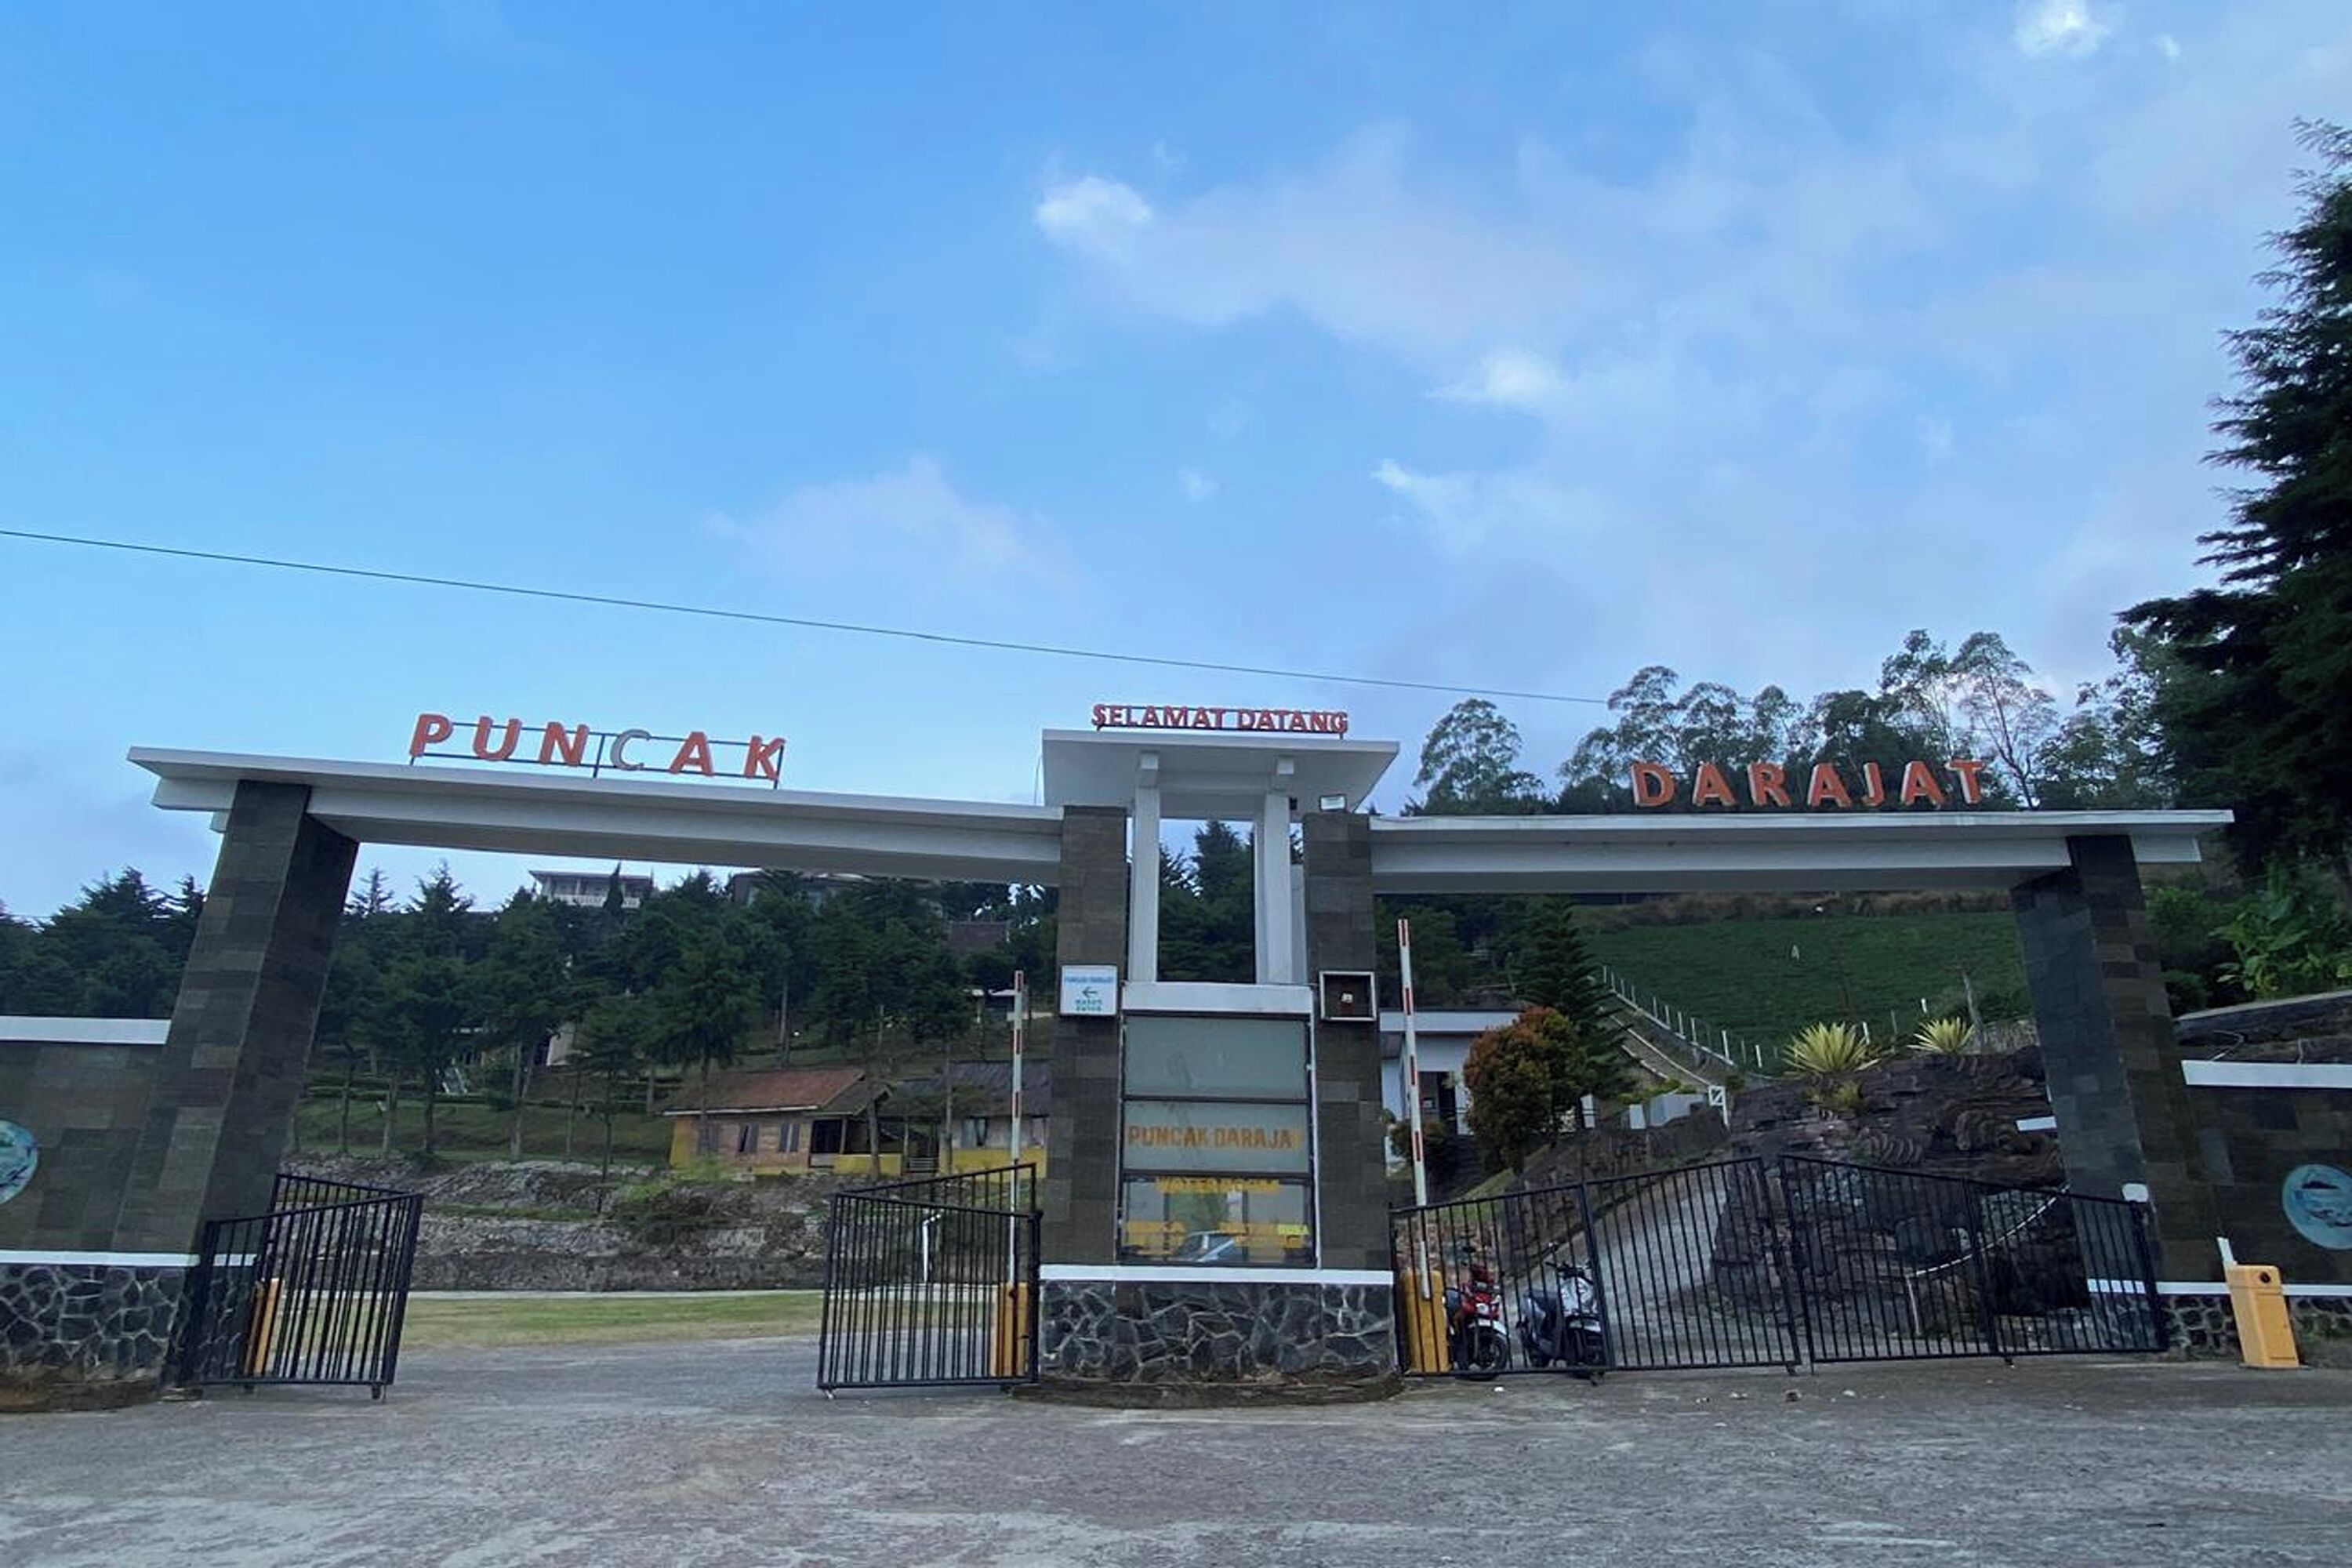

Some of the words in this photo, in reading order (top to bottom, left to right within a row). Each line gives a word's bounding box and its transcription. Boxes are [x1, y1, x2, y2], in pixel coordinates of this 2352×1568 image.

[1091, 704, 1226, 728] SELAMAT
[1236, 708, 1348, 733] DATANG
[409, 713, 786, 781] PUNCAK
[1631, 759, 1986, 808] DARAJAT
[1127, 1126, 1207, 1147] PUNCAK
